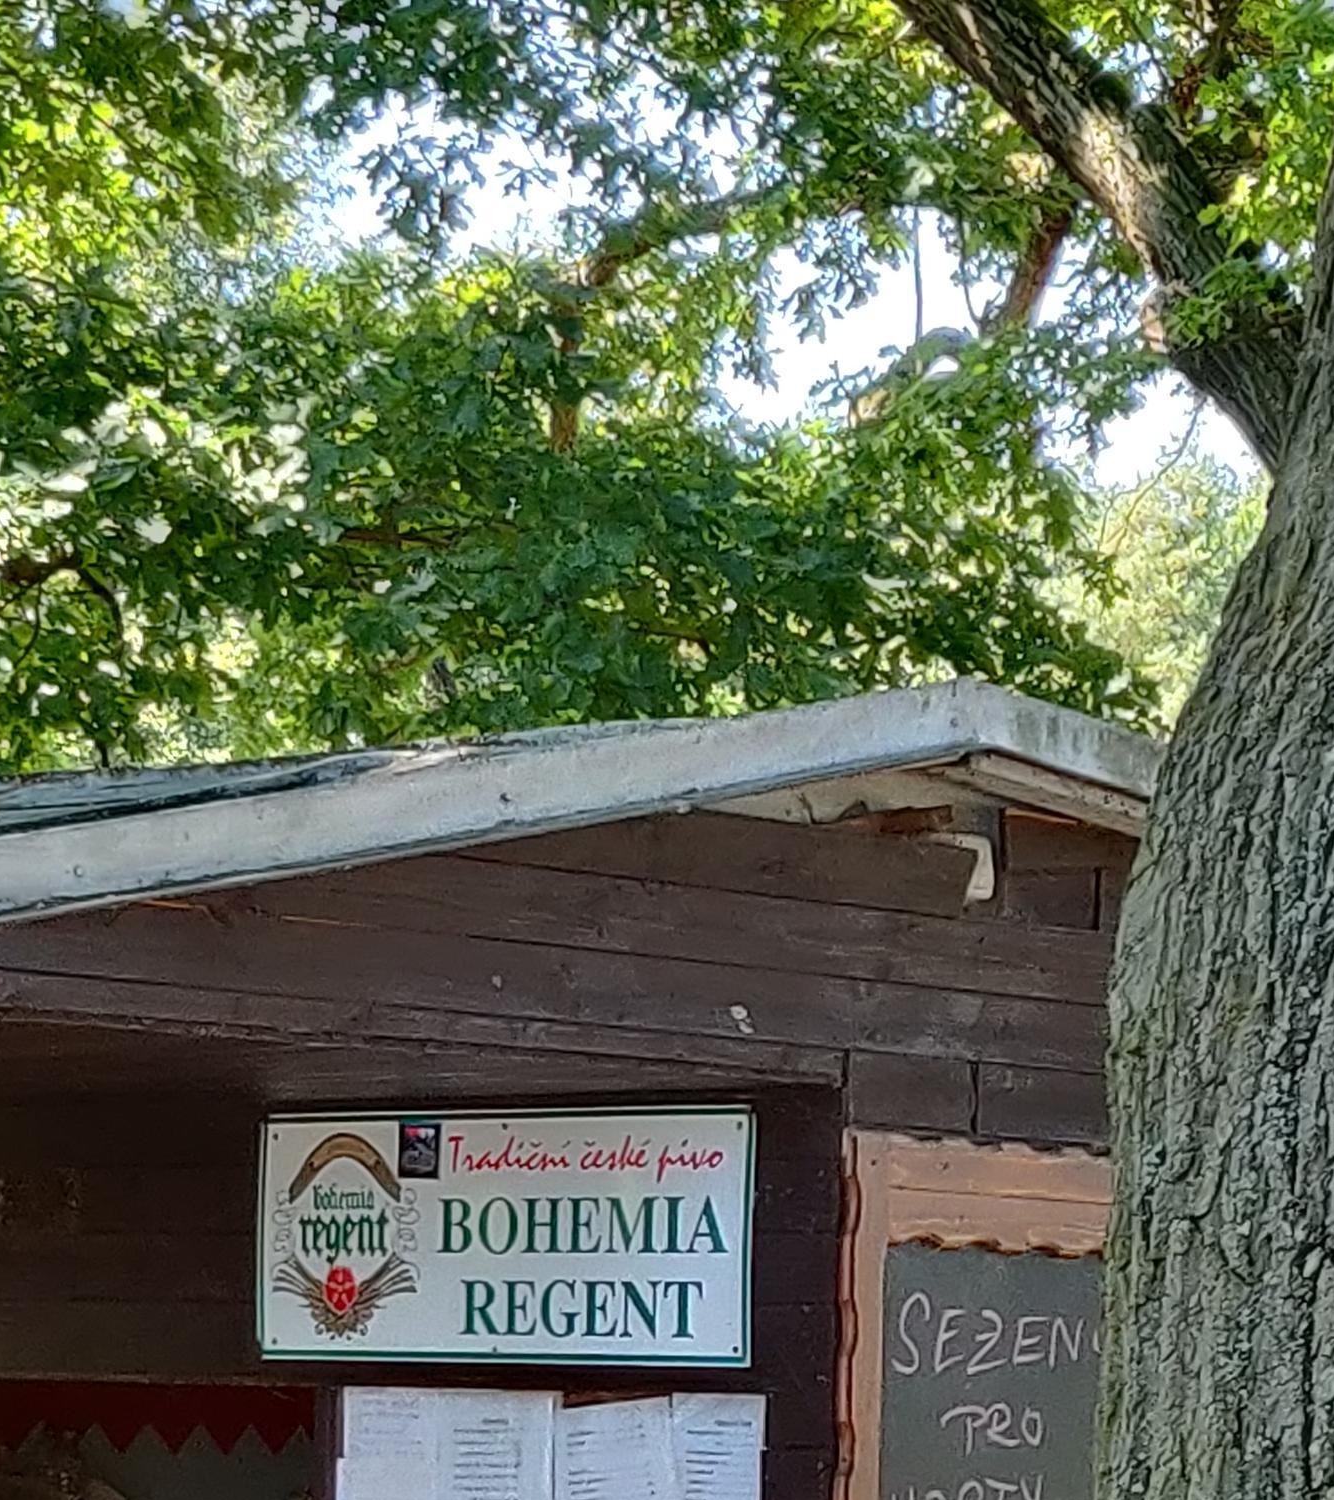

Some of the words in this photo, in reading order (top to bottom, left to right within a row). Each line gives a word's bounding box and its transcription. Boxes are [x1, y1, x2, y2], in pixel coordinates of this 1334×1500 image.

[448, 1135, 570, 1172] Tradiční
[579, 1135, 651, 1172] české
[654, 1139, 724, 1183] pivo
[299, 1208, 389, 1265] regent
[437, 1195, 729, 1255] BOHEMIA
[459, 1279, 704, 1339] REGENT
[891, 1291, 1103, 1376] SEZEN
[940, 1402, 1044, 1455] PRO
